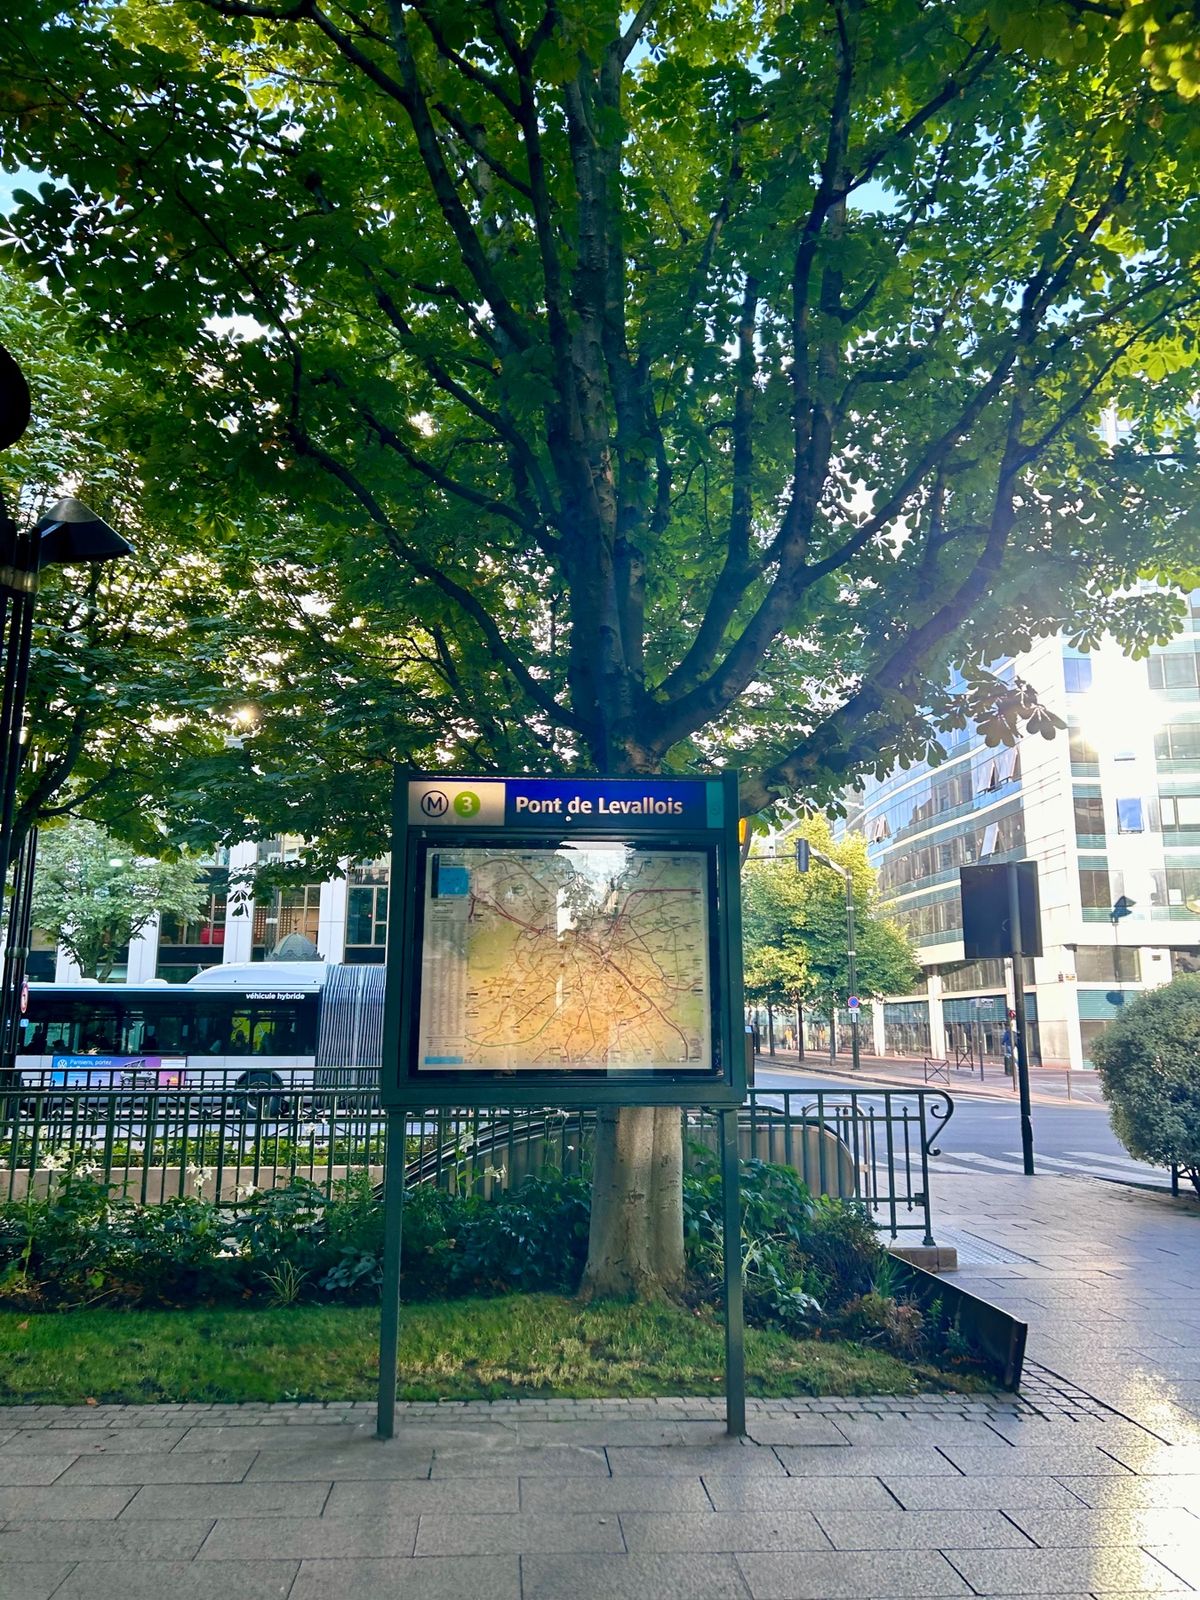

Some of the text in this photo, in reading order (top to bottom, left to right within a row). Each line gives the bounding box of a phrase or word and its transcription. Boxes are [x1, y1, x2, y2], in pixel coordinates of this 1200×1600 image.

[461, 796, 473, 813] 3
[515, 796, 683, 815] Pont de Levallois
[245, 992, 306, 1001] véhicule hybride
